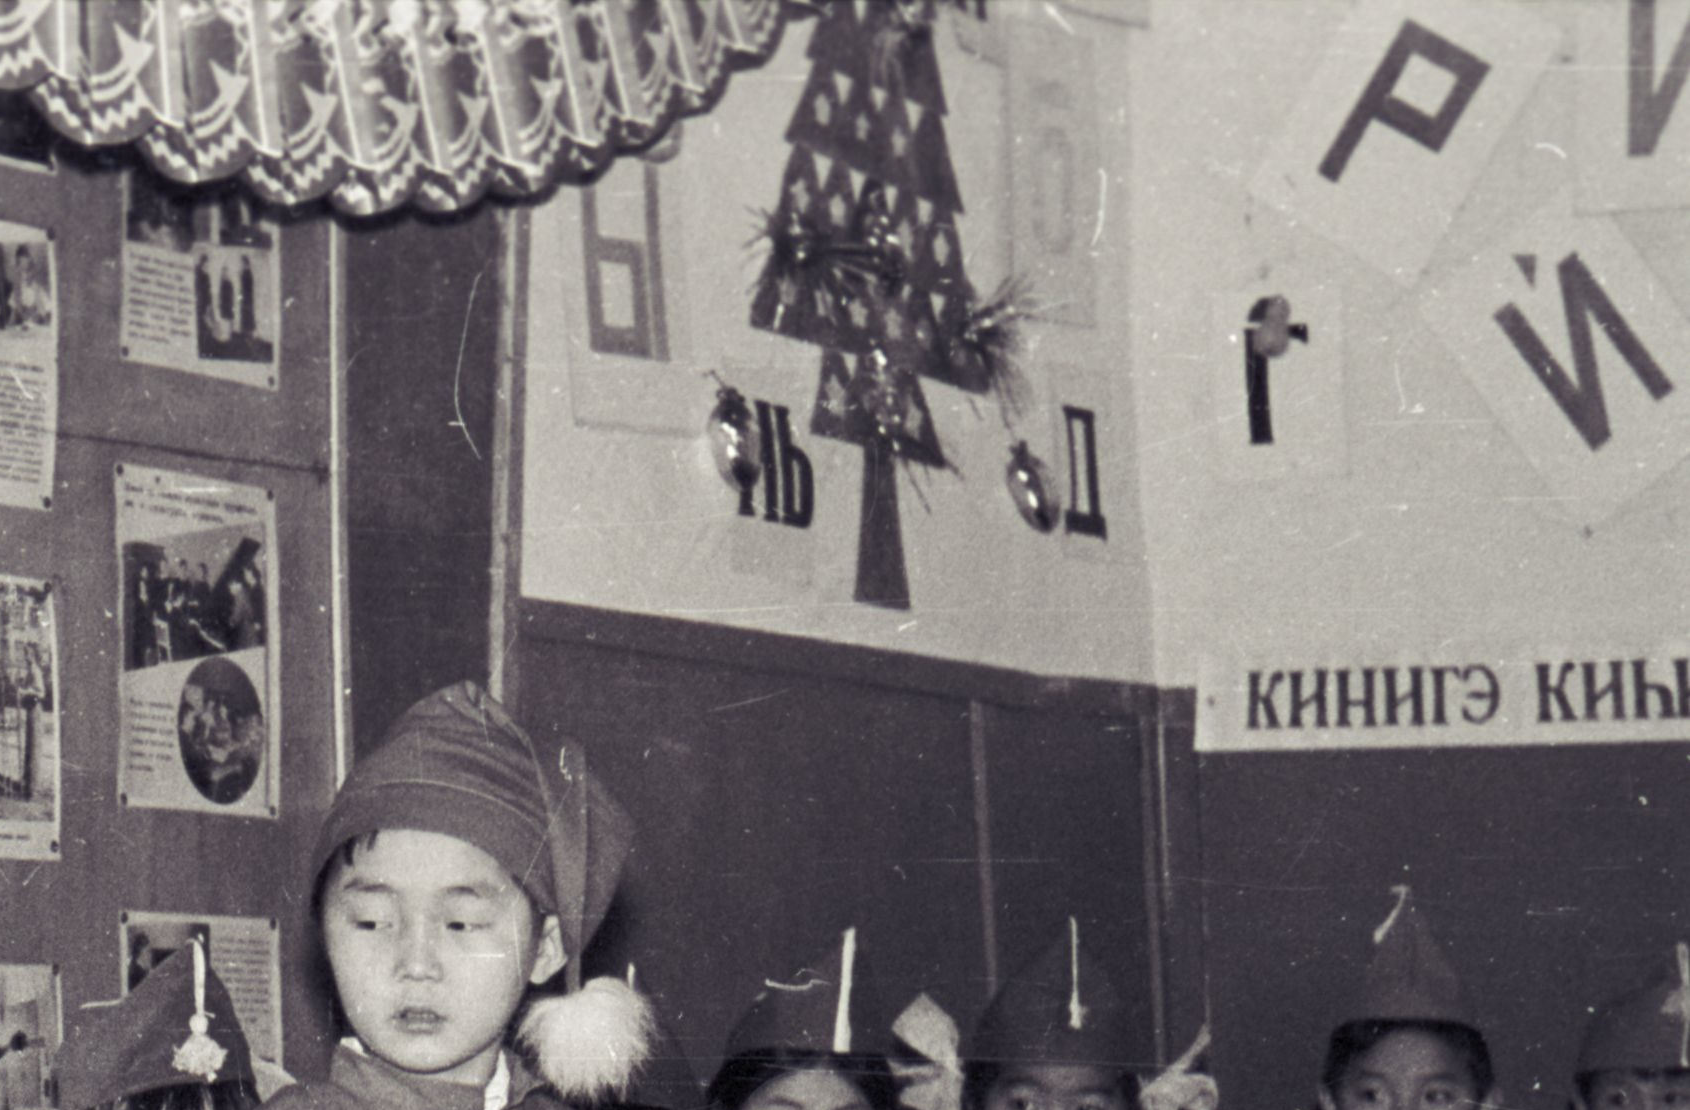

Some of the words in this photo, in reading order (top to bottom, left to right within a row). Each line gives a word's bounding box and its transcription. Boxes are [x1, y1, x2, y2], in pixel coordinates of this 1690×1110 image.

[1317, 18, 1492, 183] Р
[1492, 251, 1674, 452] Й
[1245, 664, 1501, 730] КИНИГЭ
